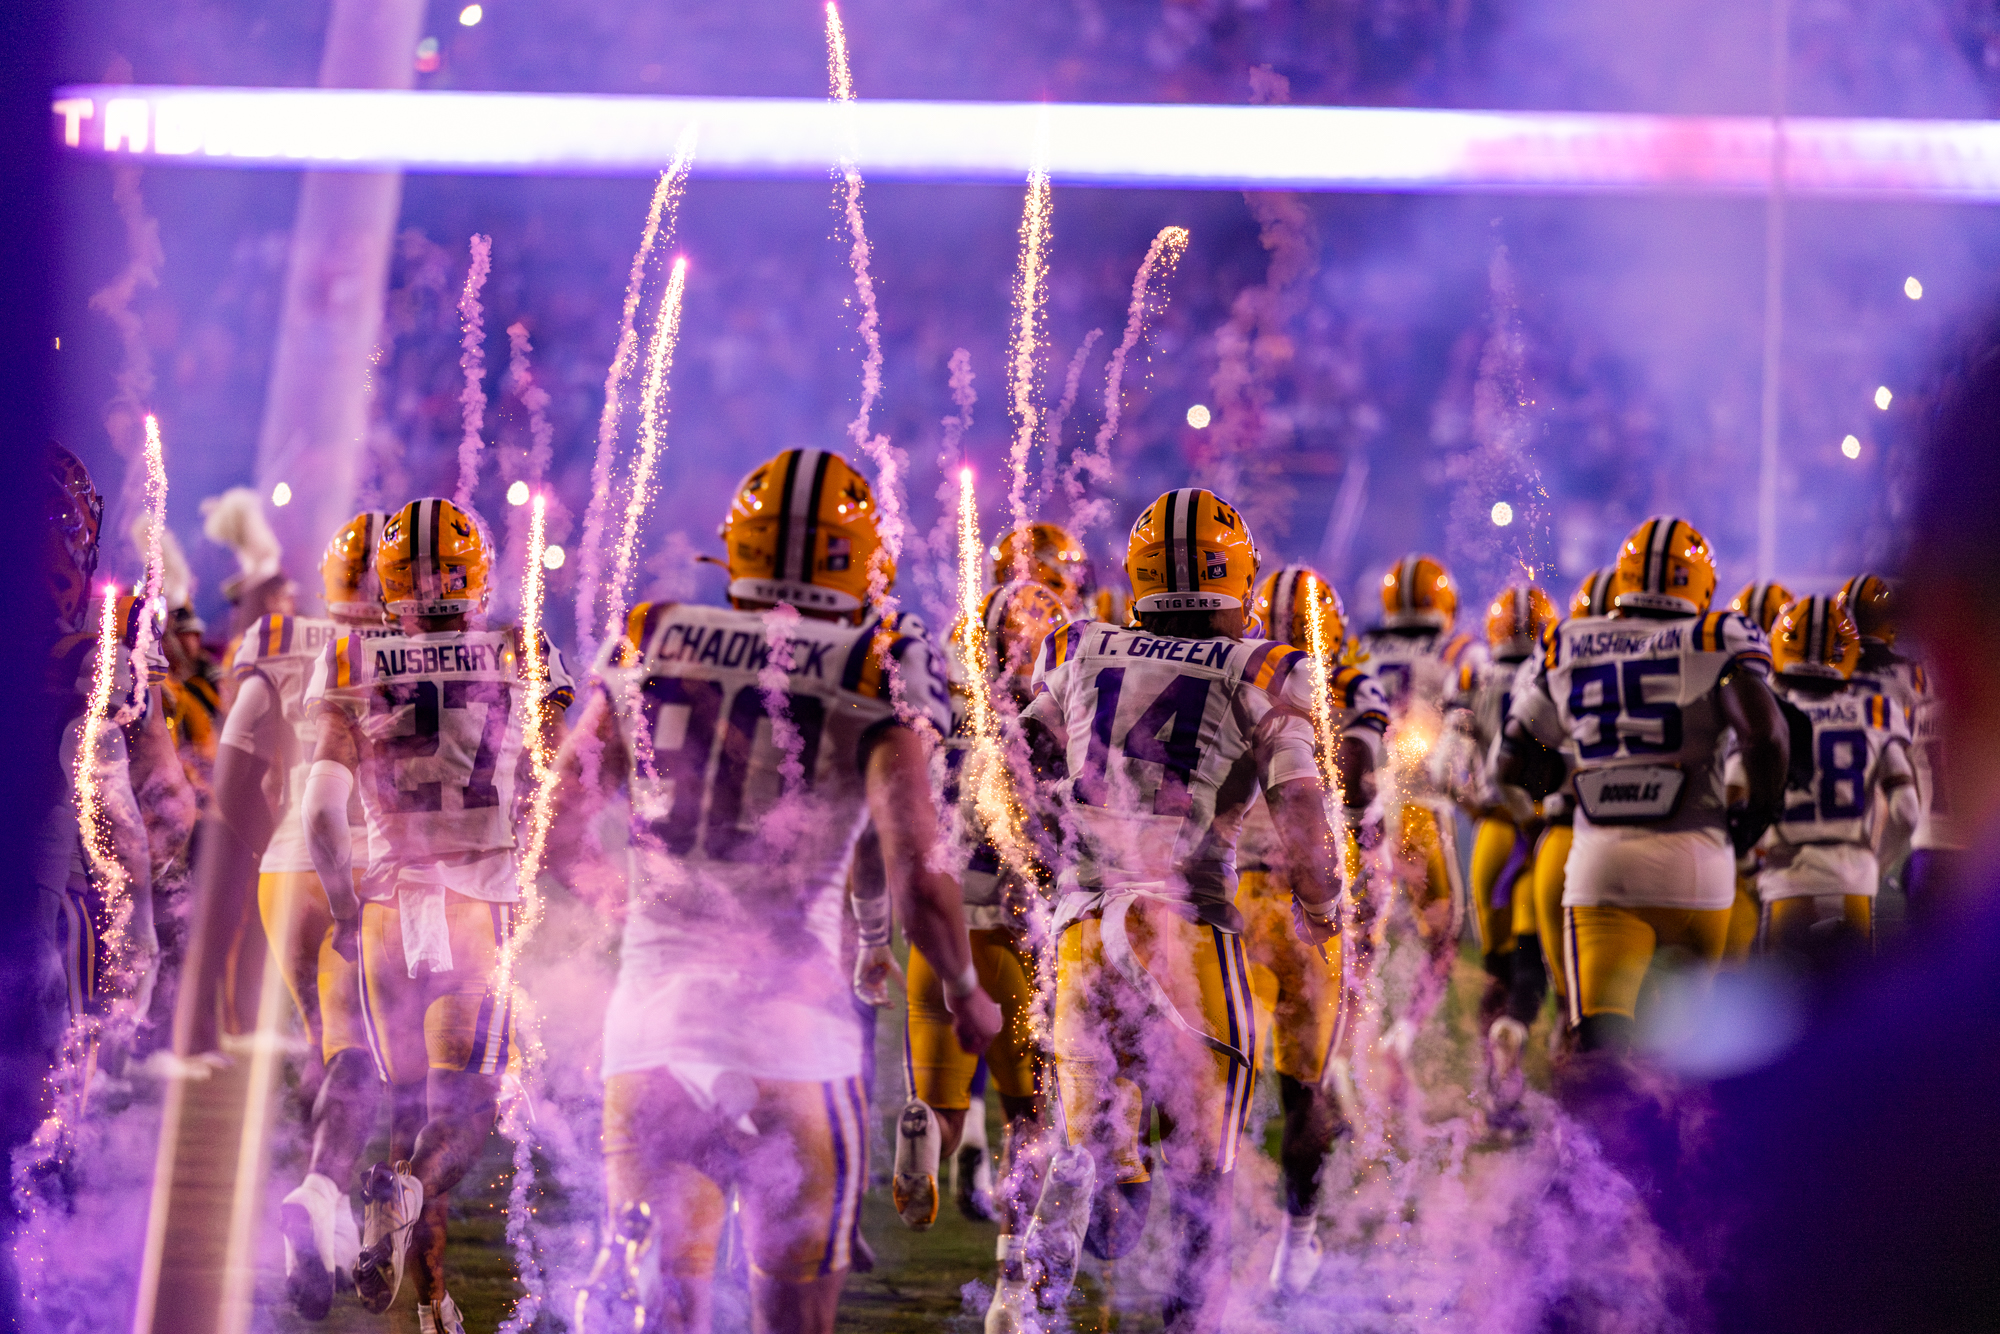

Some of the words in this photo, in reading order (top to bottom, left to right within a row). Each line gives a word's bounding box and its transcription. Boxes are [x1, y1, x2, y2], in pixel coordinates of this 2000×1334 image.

[1098, 630, 1119, 656] T.
[1127, 636, 1236, 670] GREEN
[1153, 598, 1222, 610] TIGERS
[374, 643, 505, 678] AUSBERRY
[1568, 656, 1683, 760] 95
[368, 680, 512, 815] 27
[632, 676, 827, 862] 90
[1071, 666, 1212, 818] 14
